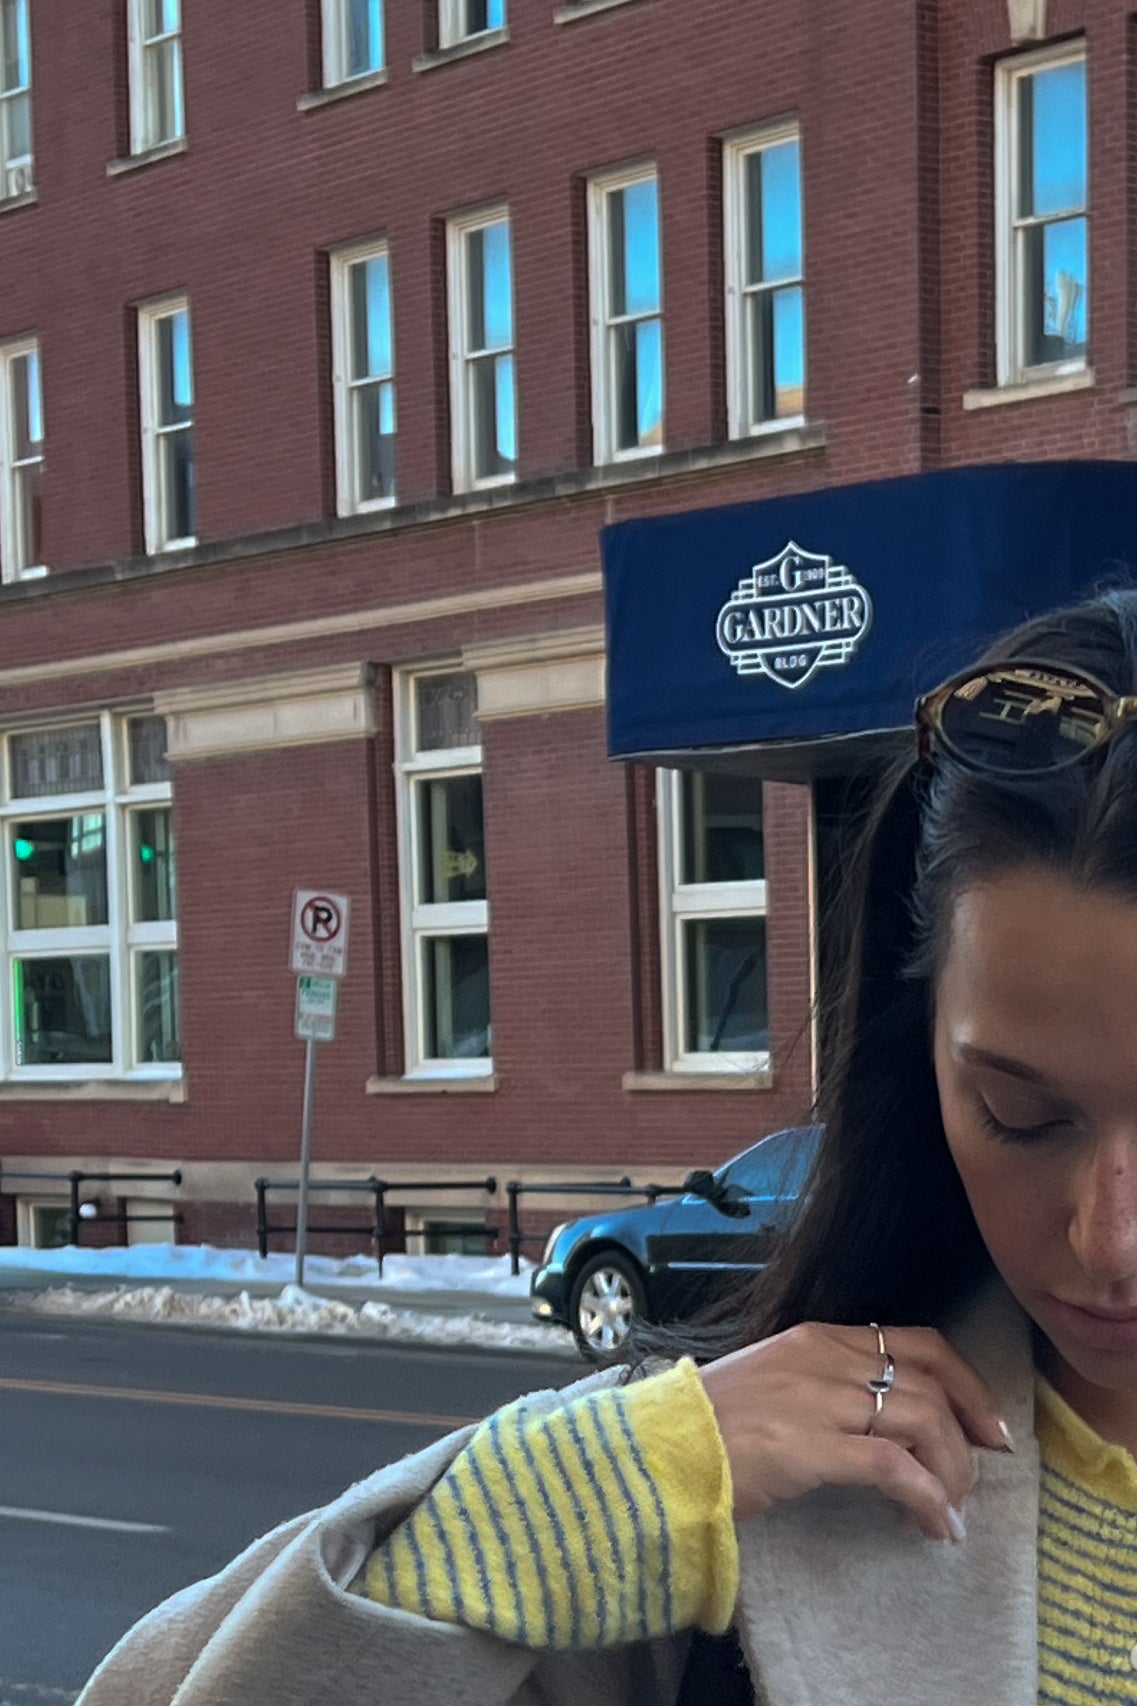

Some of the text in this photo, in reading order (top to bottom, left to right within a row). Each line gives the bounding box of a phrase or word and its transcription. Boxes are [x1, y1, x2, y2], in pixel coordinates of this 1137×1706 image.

[779, 556, 804, 592] G
[723, 596, 863, 644] GARDNER
[773, 654, 808, 670] BLDG
